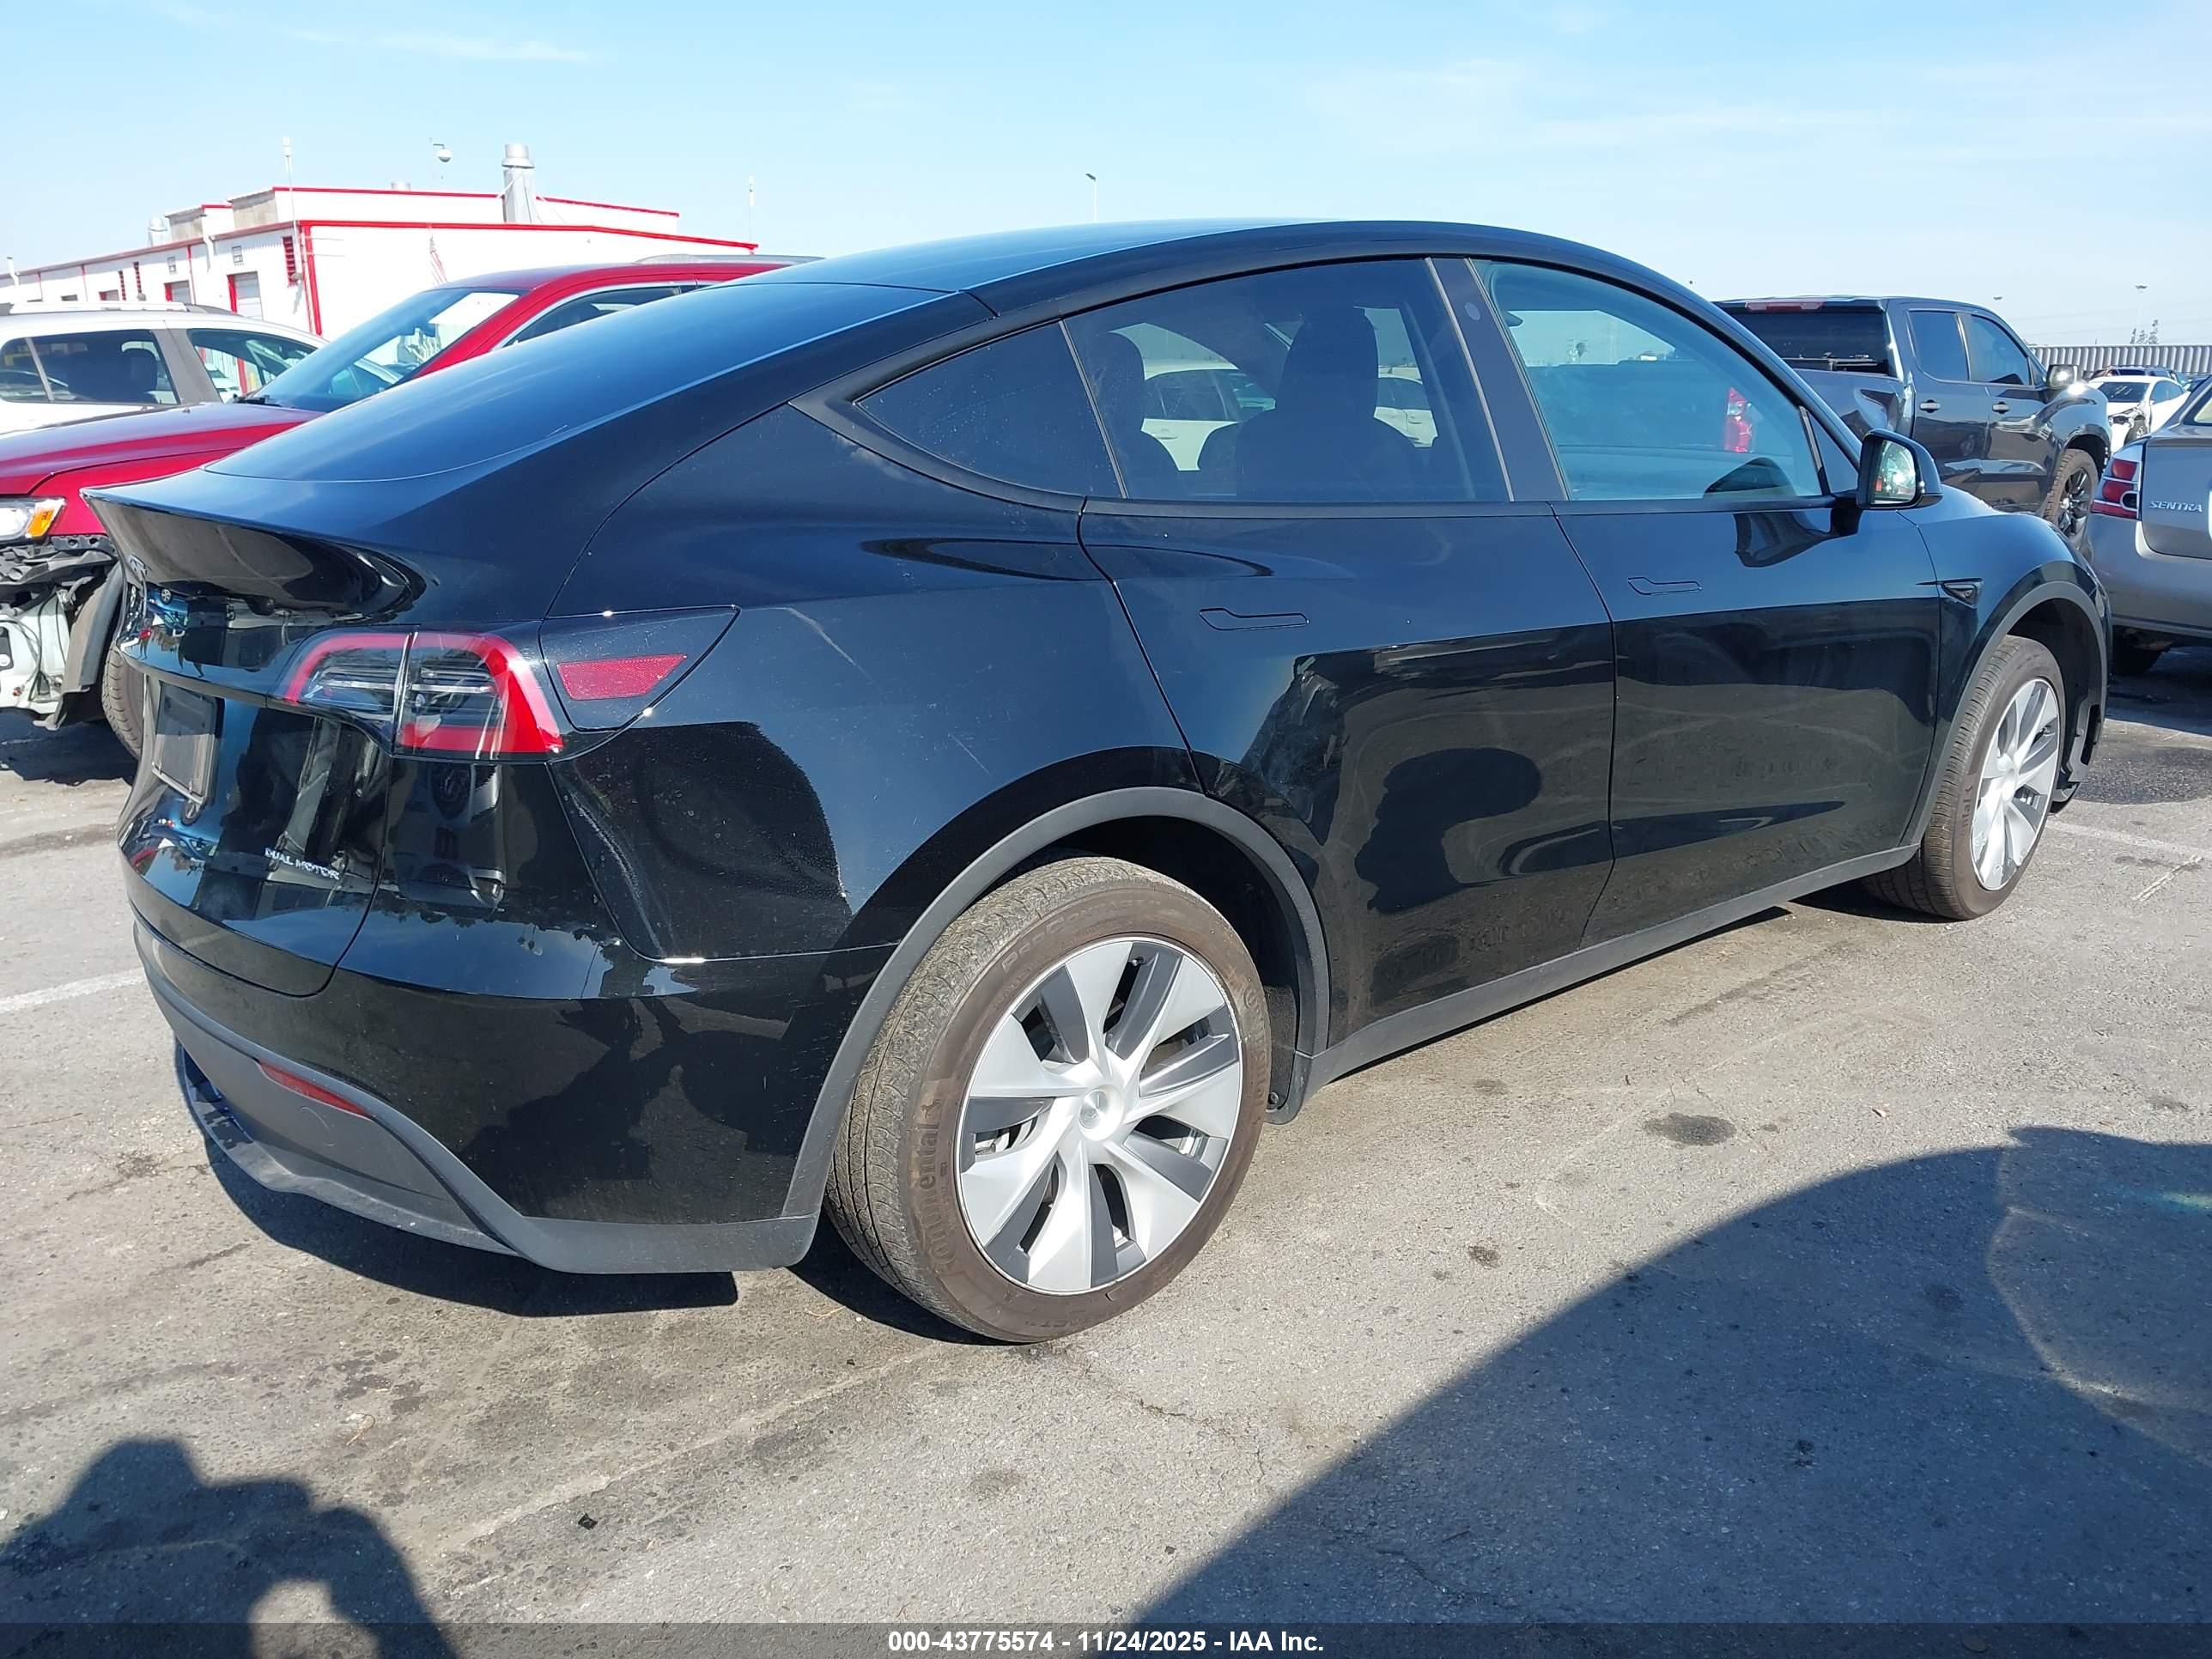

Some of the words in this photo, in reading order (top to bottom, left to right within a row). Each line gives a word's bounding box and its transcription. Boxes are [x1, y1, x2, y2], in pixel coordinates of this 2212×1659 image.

[2149, 501, 2203, 512] SENTRA
[264, 848, 294, 866] DUAL
[295, 859, 340, 880] MOTOR
